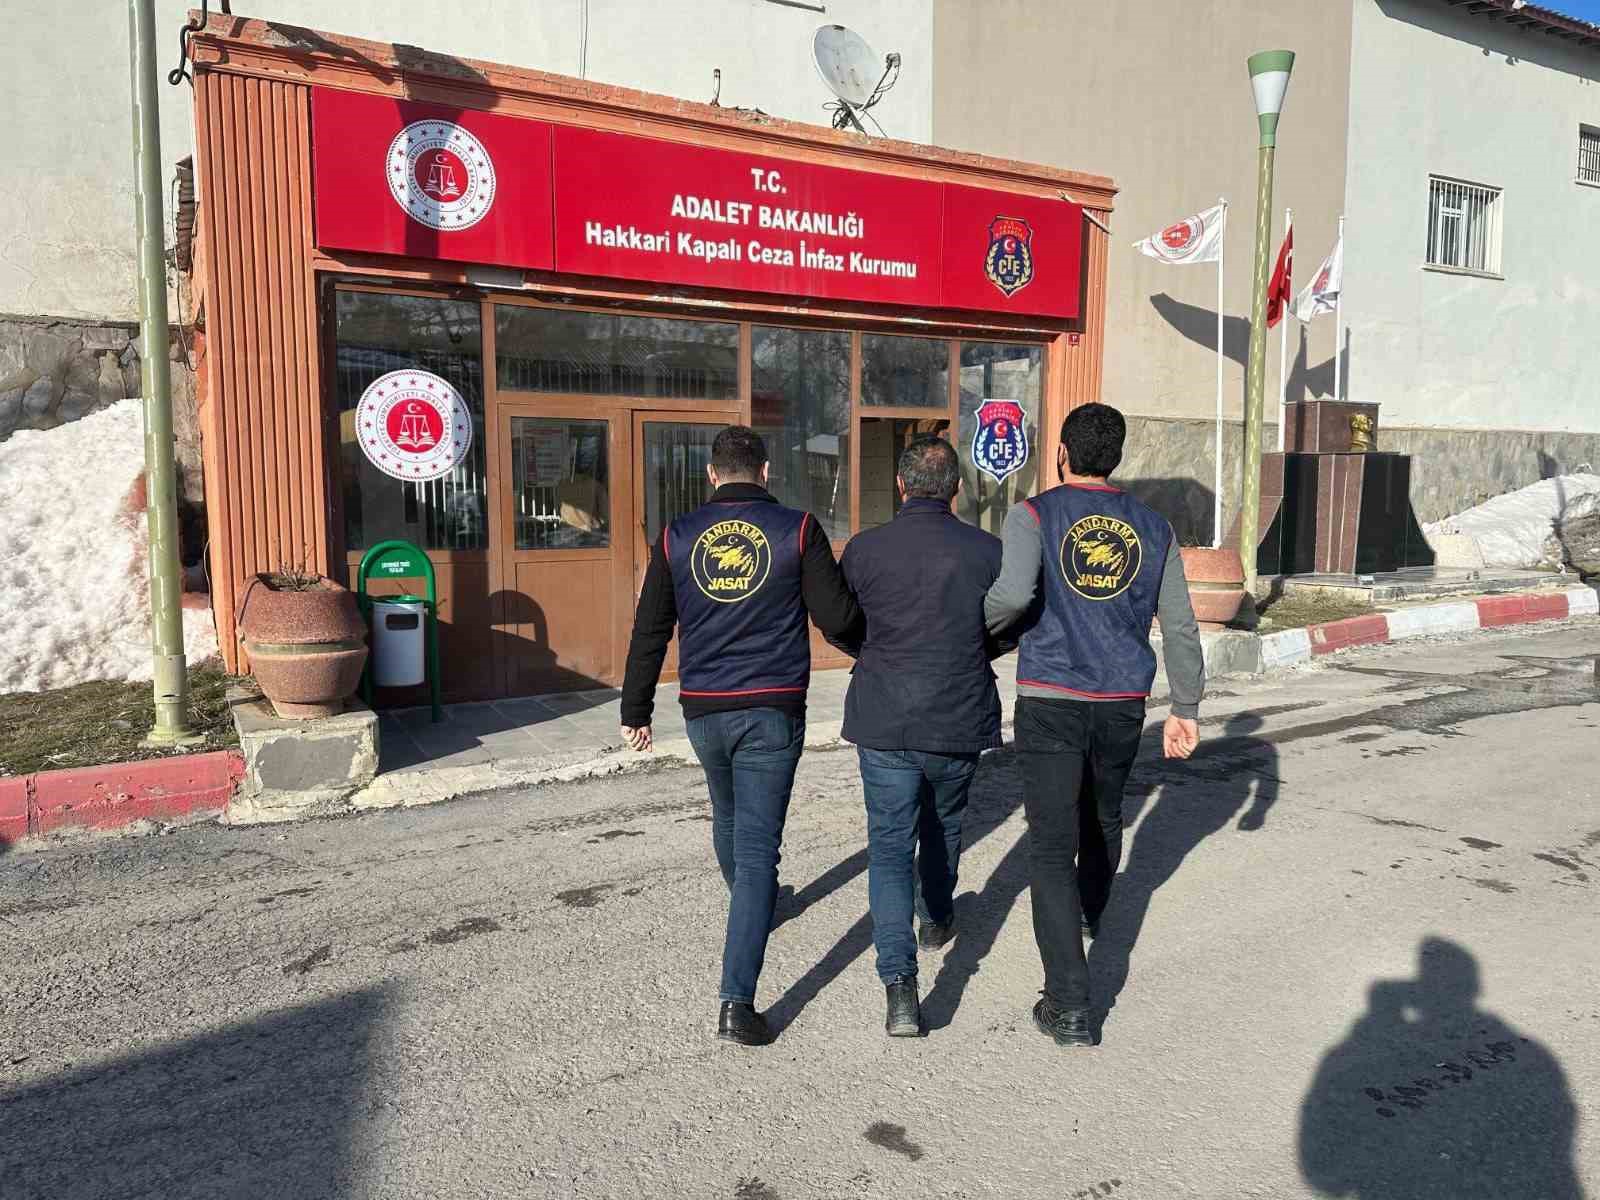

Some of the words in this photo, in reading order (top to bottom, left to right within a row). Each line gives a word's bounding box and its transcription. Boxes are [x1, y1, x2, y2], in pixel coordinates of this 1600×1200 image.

[751, 168, 787, 194] T.C.
[671, 195, 752, 225] ADALET
[759, 207, 865, 238] BAKANLIĞI
[585, 222, 671, 253] Hakkari
[677, 232, 742, 262] Kapalı
[748, 243, 795, 267] Ceza
[800, 241, 845, 272] İnfaz
[850, 252, 918, 279] Kurumu
[998, 254, 1021, 275] CTE
[989, 438, 1013, 460] CTE
[701, 522, 765, 548] JANDARMA
[1071, 518, 1137, 548] JANDARMA
[708, 577, 751, 590] JASAT
[1076, 574, 1121, 588] JASAT
